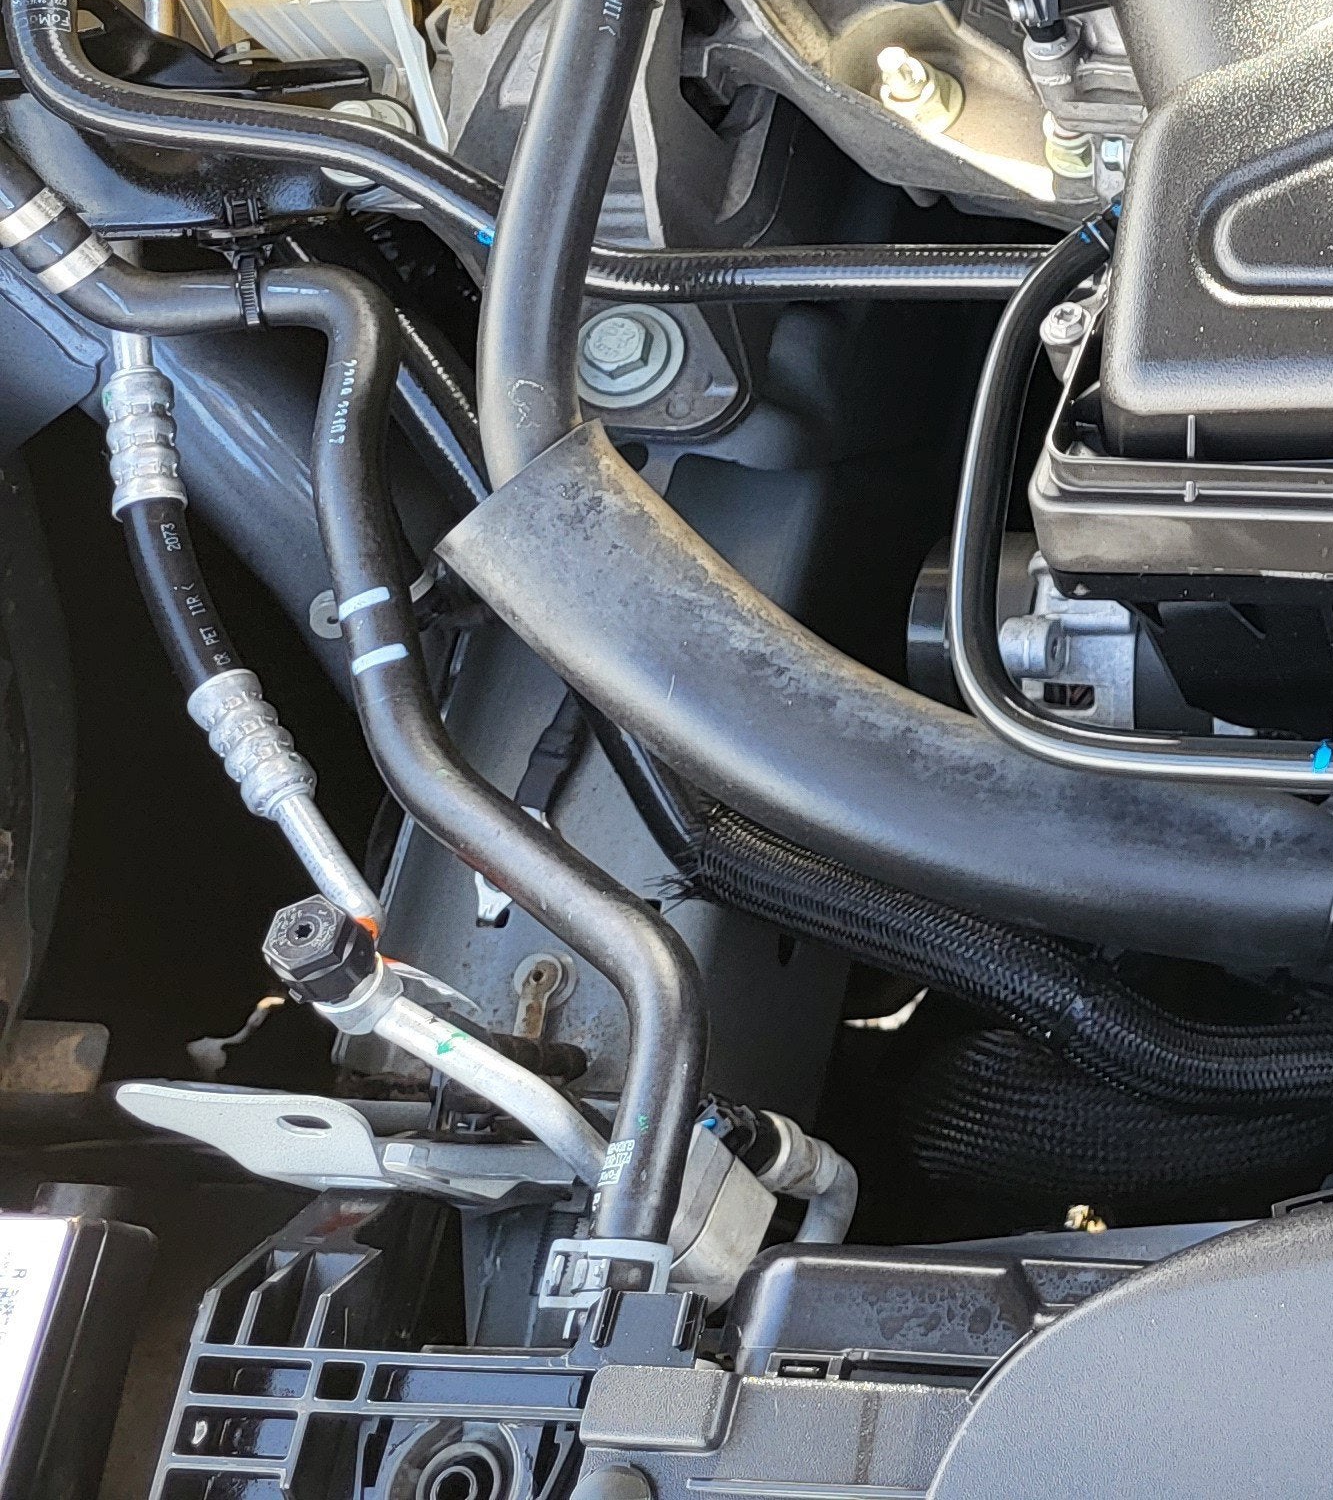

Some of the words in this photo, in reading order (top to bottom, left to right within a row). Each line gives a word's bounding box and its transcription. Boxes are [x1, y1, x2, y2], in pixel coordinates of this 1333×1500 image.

[160, 522, 181, 551] 2073
[186, 594, 206, 616] IIR
[199, 626, 220, 646] PET
